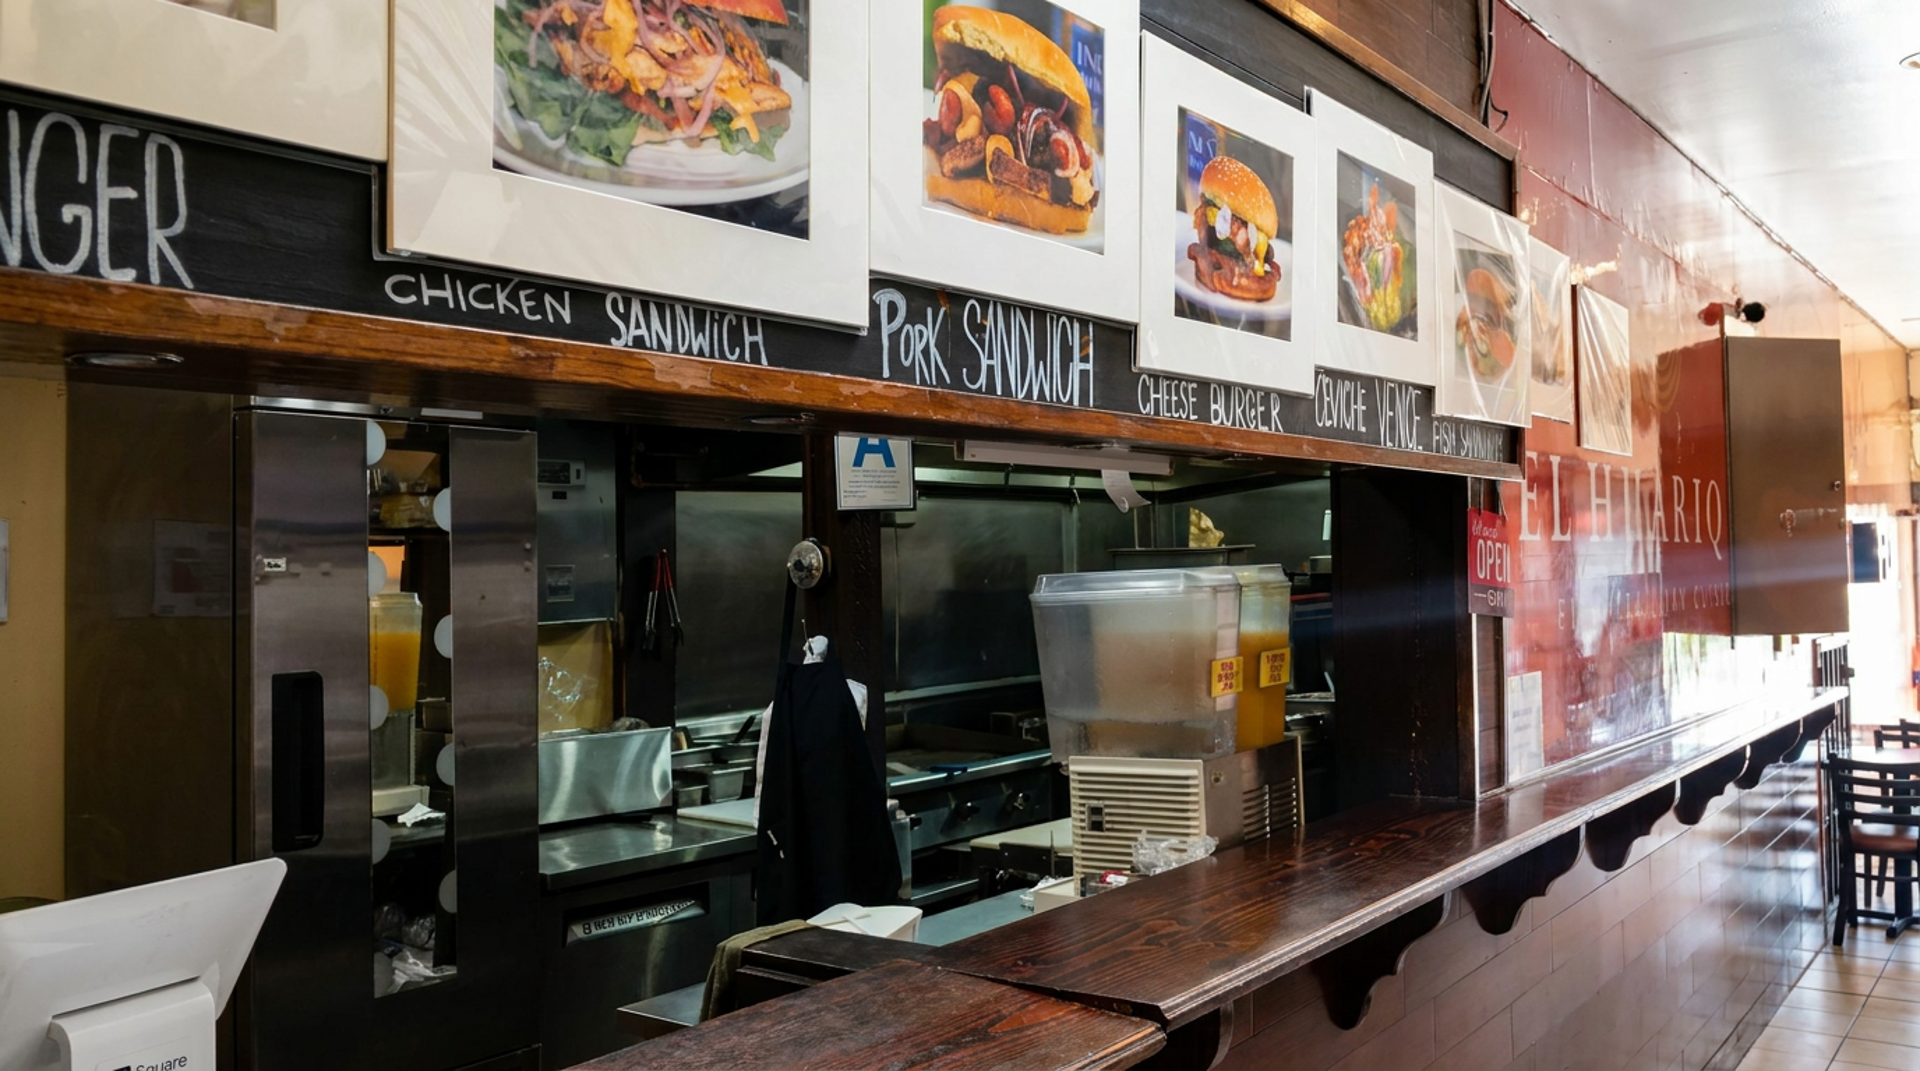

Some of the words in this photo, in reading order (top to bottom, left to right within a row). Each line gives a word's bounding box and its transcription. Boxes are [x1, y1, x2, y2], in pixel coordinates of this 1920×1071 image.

[384, 273, 571, 324] CHICKEN
[872, 287, 951, 386] PORK
[962, 298, 1094, 408] SANDWICH
[1137, 373, 1199, 421] CHEESE
[1210, 382, 1284, 434] BURGER
[1315, 370, 1367, 433] CEVICHE
[852, 437, 896, 468] A
[1518, 450, 1572, 542] EL
[1476, 538, 1511, 584] OPEN
